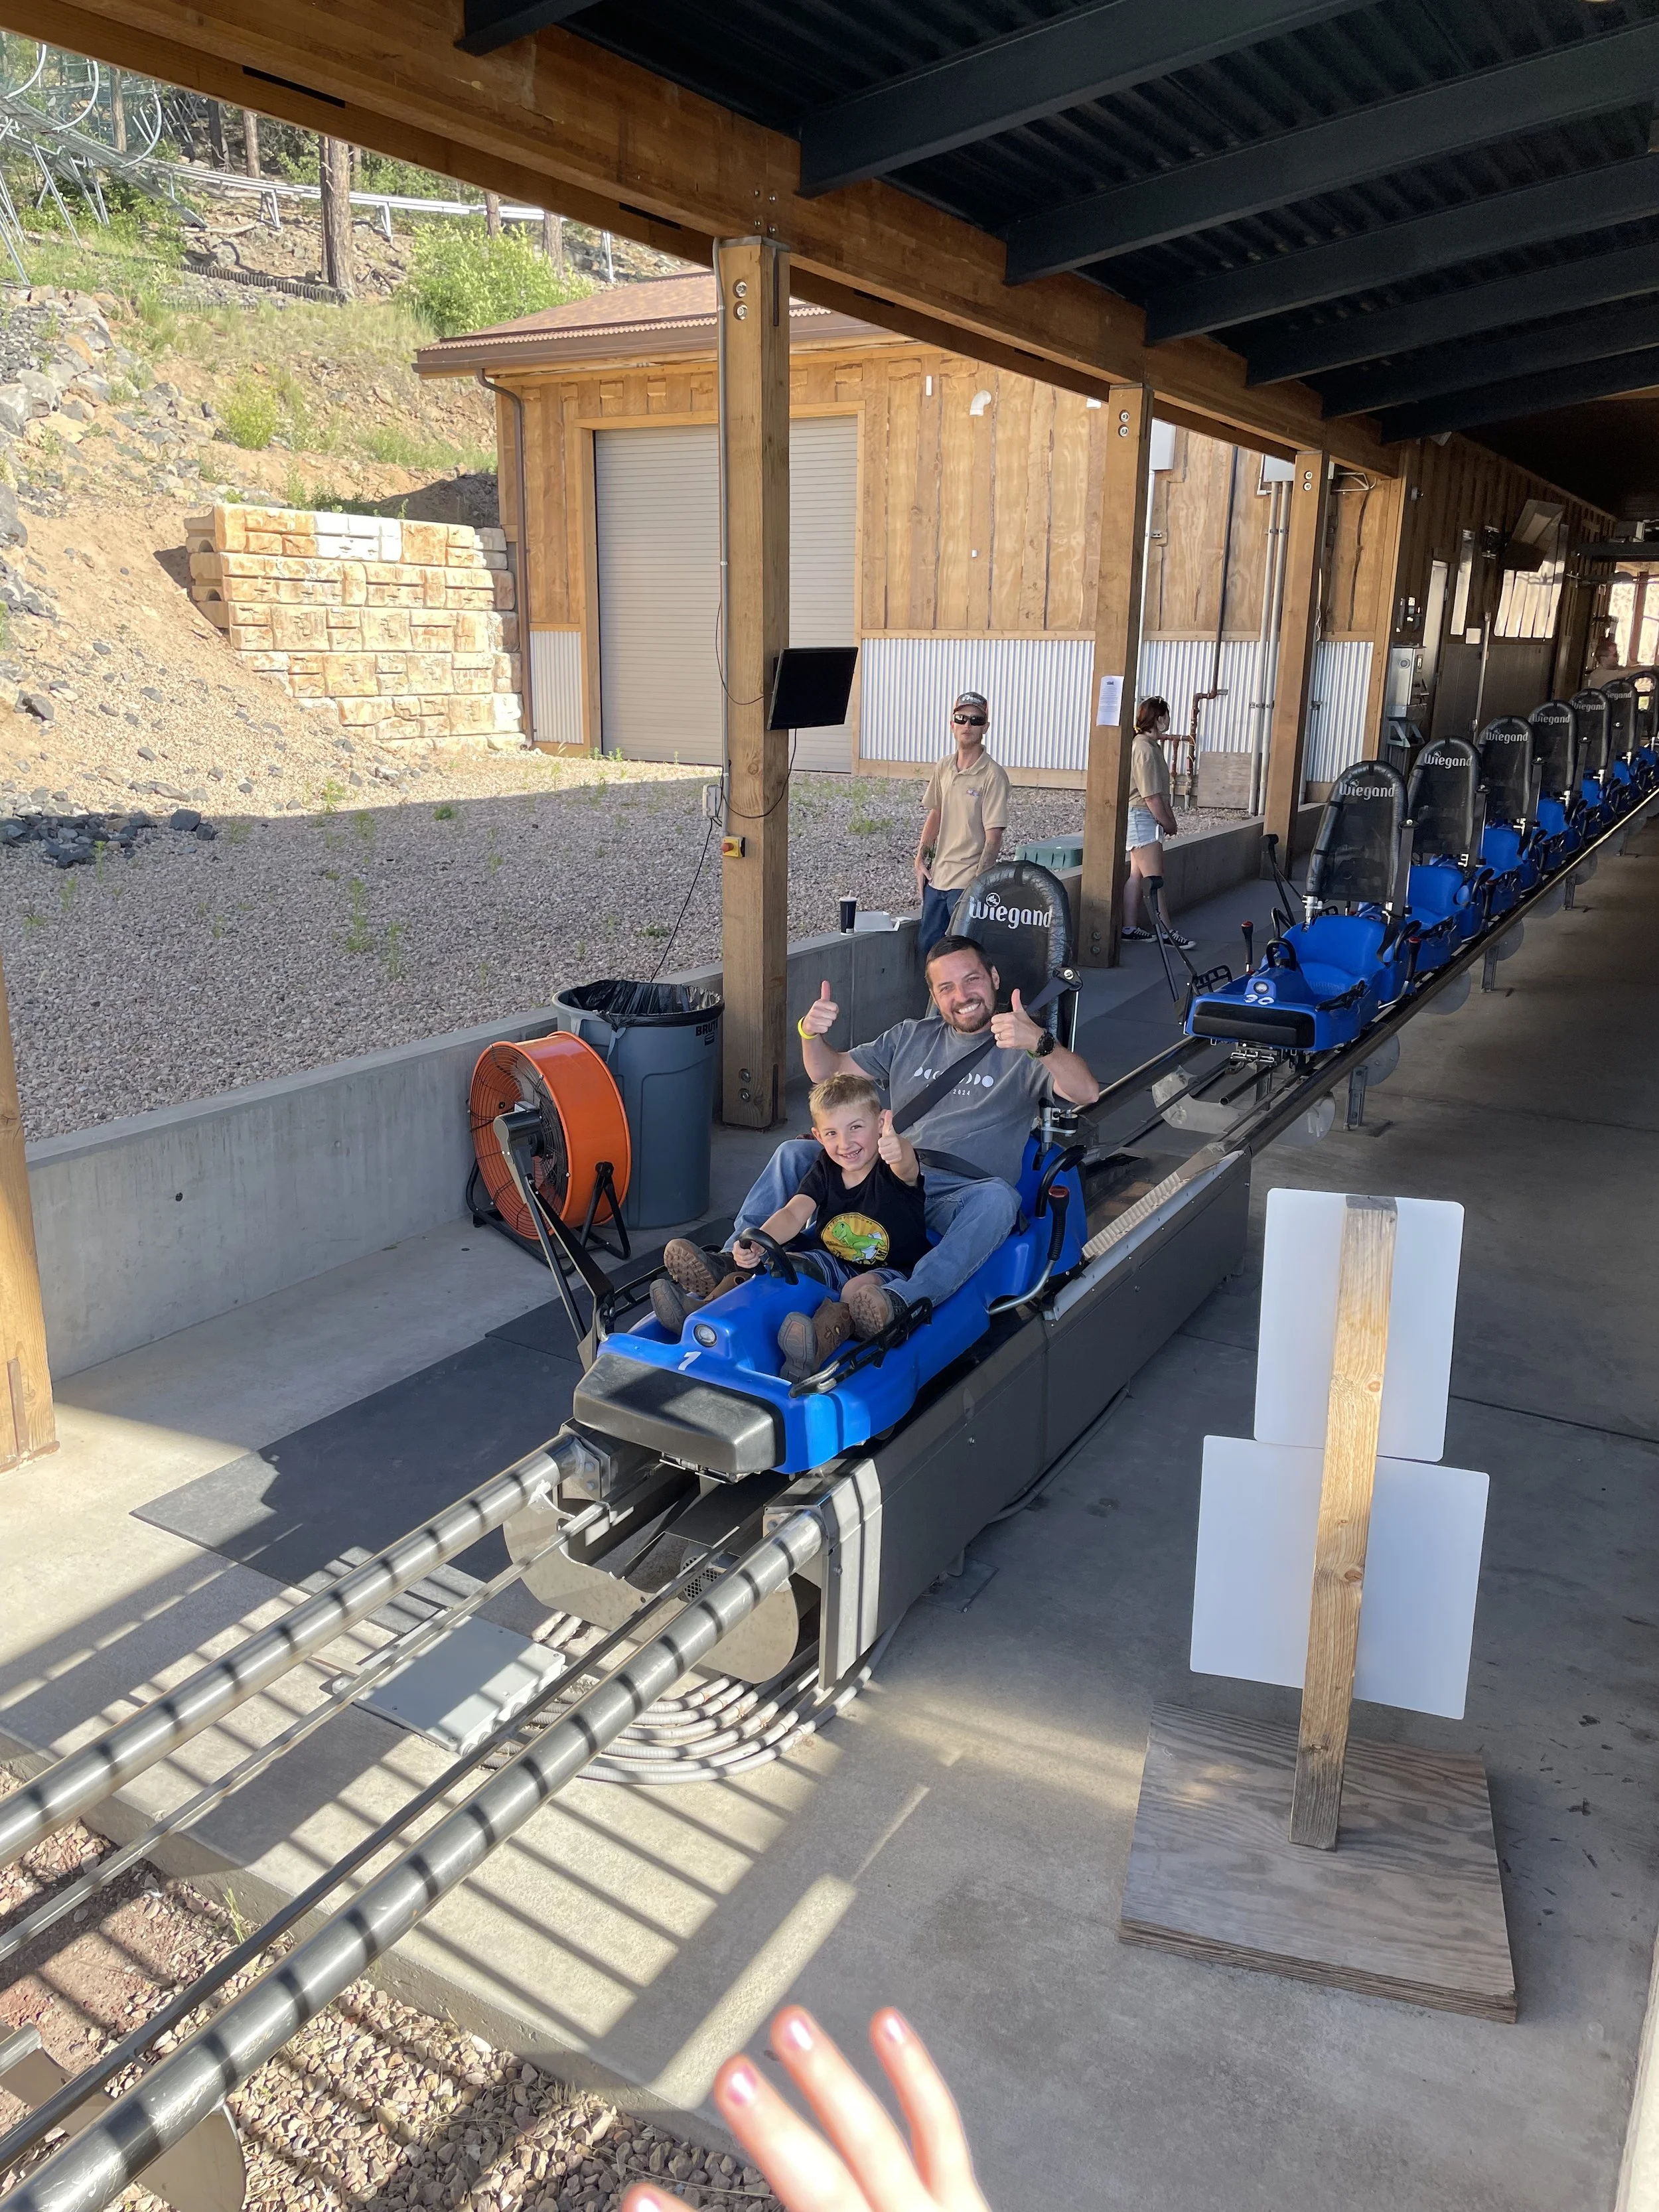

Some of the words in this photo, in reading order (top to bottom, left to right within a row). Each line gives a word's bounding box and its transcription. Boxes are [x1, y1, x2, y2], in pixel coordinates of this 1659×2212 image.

[1606, 690, 1633, 701] iegand
[1532, 713, 1571, 725] Wiegand
[1486, 729, 1529, 744] Wiegand
[1424, 751, 1473, 769] Wiegand
[1339, 780, 1396, 800] Wiegand
[969, 893, 1053, 929] Wiegand
[1244, 994, 1274, 1005] 30
[678, 1351, 702, 1371] 1
